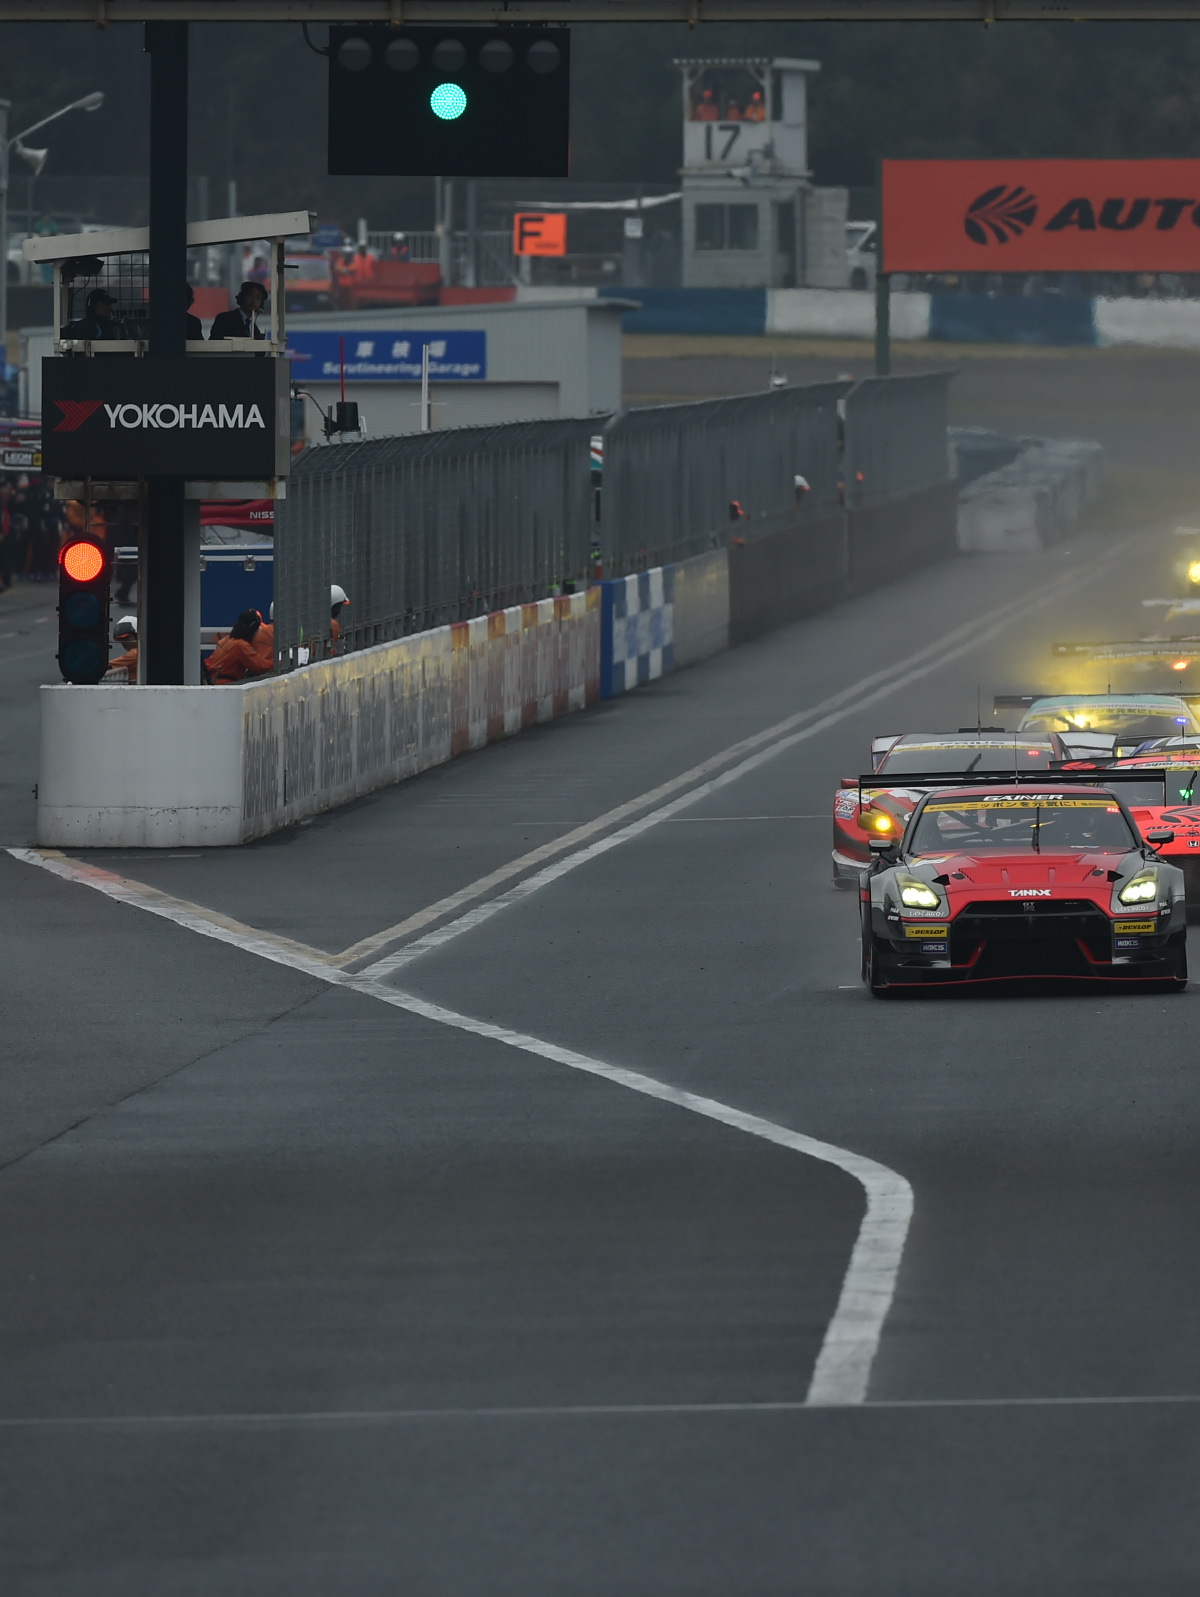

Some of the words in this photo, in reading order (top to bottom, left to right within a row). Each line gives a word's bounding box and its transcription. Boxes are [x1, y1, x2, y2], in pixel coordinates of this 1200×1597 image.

[705, 124, 741, 160] 17
[519, 216, 545, 251] F
[322, 361, 421, 376] Scrutineering
[427, 361, 480, 376] Garage
[103, 403, 266, 429] YOKOHAMA
